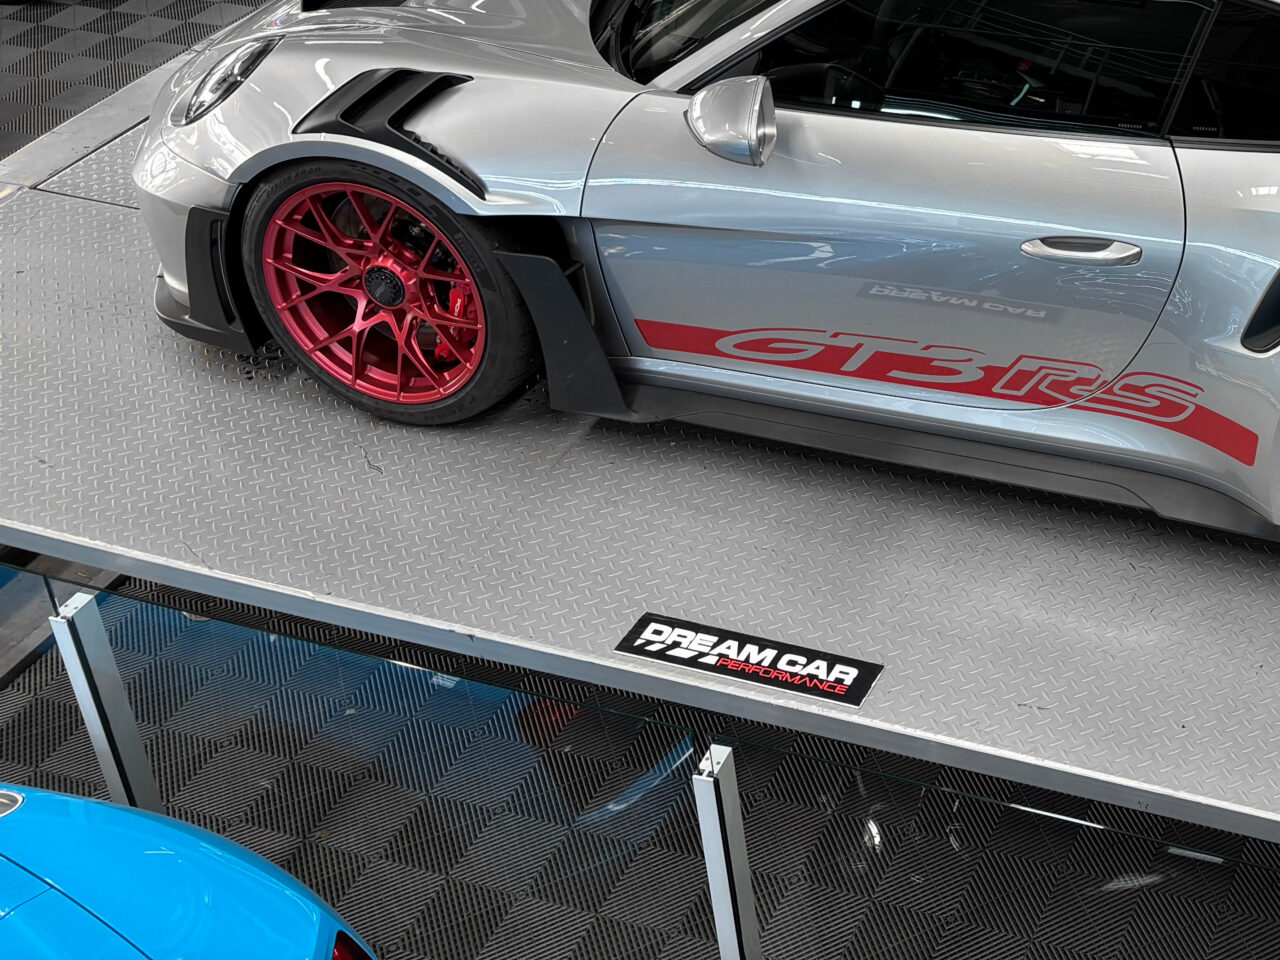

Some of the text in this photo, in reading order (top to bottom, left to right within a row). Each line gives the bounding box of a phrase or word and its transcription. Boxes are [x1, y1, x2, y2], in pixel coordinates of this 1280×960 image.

[639, 621, 859, 686] DREAM CAR
[716, 657, 849, 695] PERFORMANCE
